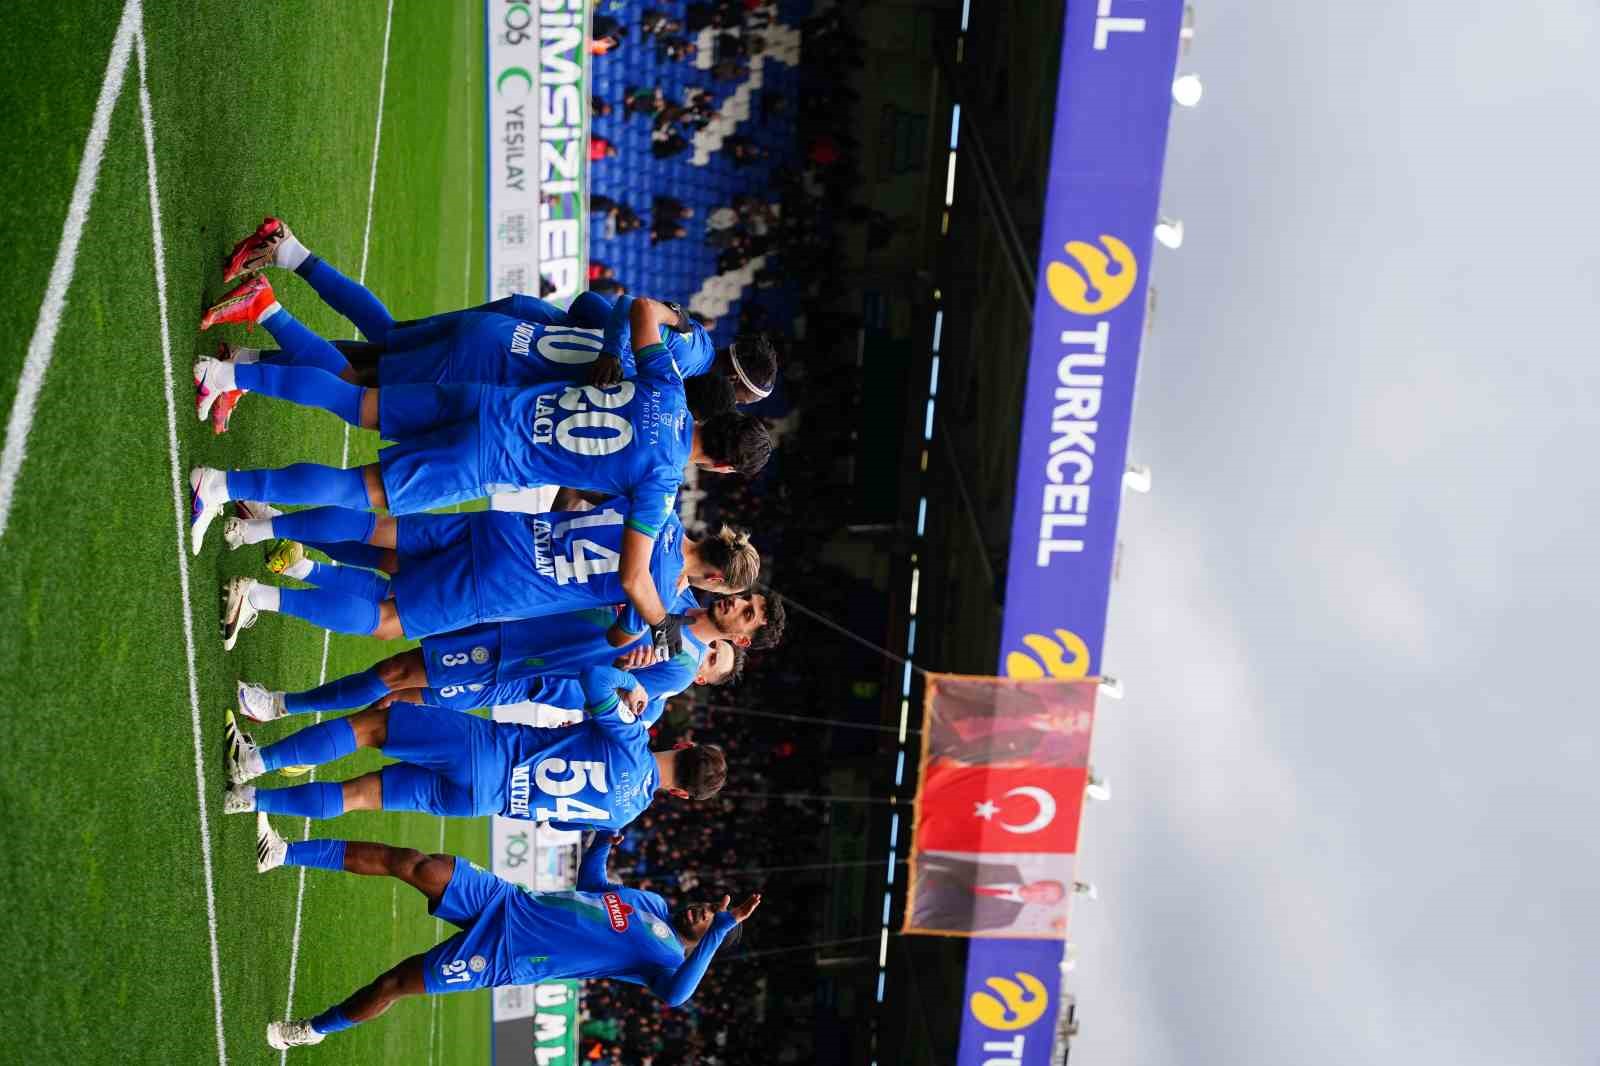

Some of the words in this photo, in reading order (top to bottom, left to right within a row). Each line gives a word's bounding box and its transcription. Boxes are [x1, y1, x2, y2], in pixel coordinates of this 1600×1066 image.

[1093, 0, 1146, 50] L
[536, 325, 605, 364] 10
[555, 381, 635, 456] 20
[1036, 320, 1110, 567] TURKCELL
[552, 508, 624, 586] 14
[442, 653, 469, 667] 3
[534, 757, 610, 822] 54
[441, 960, 471, 984] 27
